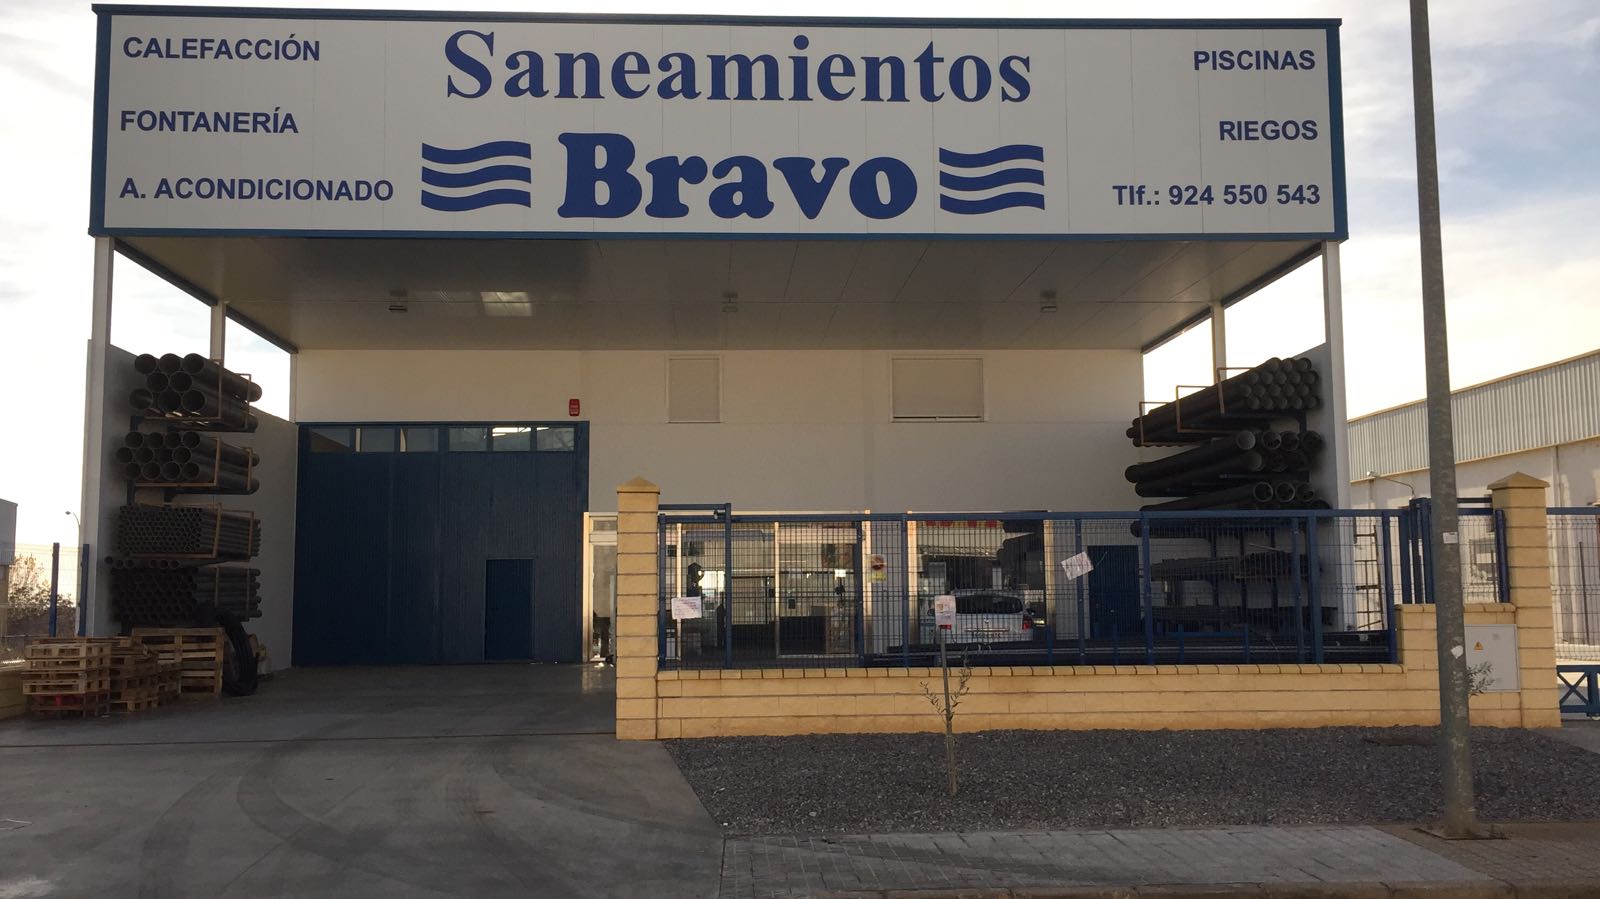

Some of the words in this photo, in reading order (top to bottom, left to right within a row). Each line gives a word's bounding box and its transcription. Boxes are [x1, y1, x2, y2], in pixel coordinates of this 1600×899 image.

[123, 34, 319, 61] CALEFACCIÓN
[445, 31, 1030, 103] Saneamientos
[1194, 50, 1315, 70] PISCINAS
[121, 107, 298, 133] FONTANERÍA
[1220, 120, 1318, 140] RIEGOS
[557, 133, 917, 219] Bravo
[120, 178, 146, 198] A.
[154, 178, 393, 201] ACONDICIONADO
[1112, 185, 1159, 205] Tlf.:
[1169, 185, 1214, 205] 924
[1224, 185, 1267, 204] 550
[1277, 185, 1320, 204] 543
